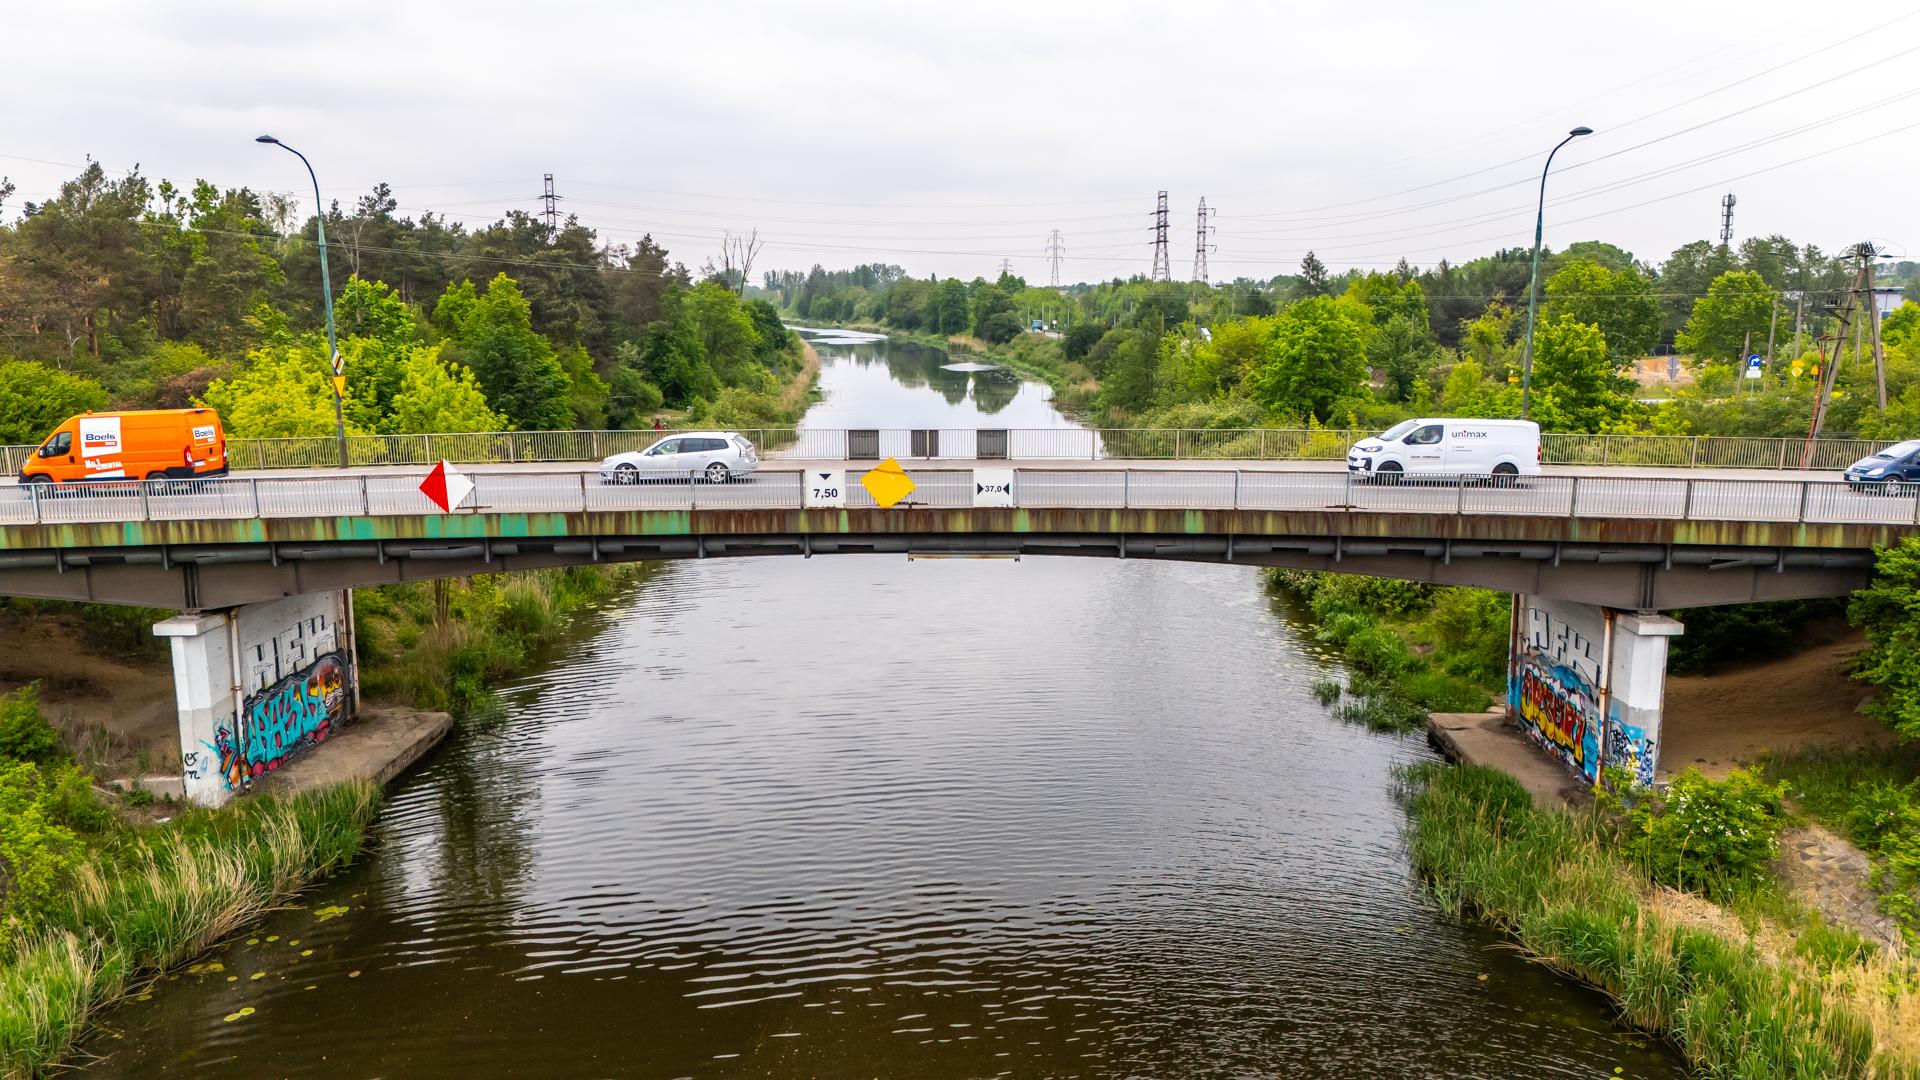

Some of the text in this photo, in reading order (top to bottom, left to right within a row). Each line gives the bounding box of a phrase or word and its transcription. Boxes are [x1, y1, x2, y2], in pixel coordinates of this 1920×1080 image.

[86, 433, 116, 441] Boels
[194, 428, 214, 438] Boels
[1451, 430, 1487, 438] unimax
[813, 488, 838, 499] 7,50
[985, 485, 1002, 494] 37,0
